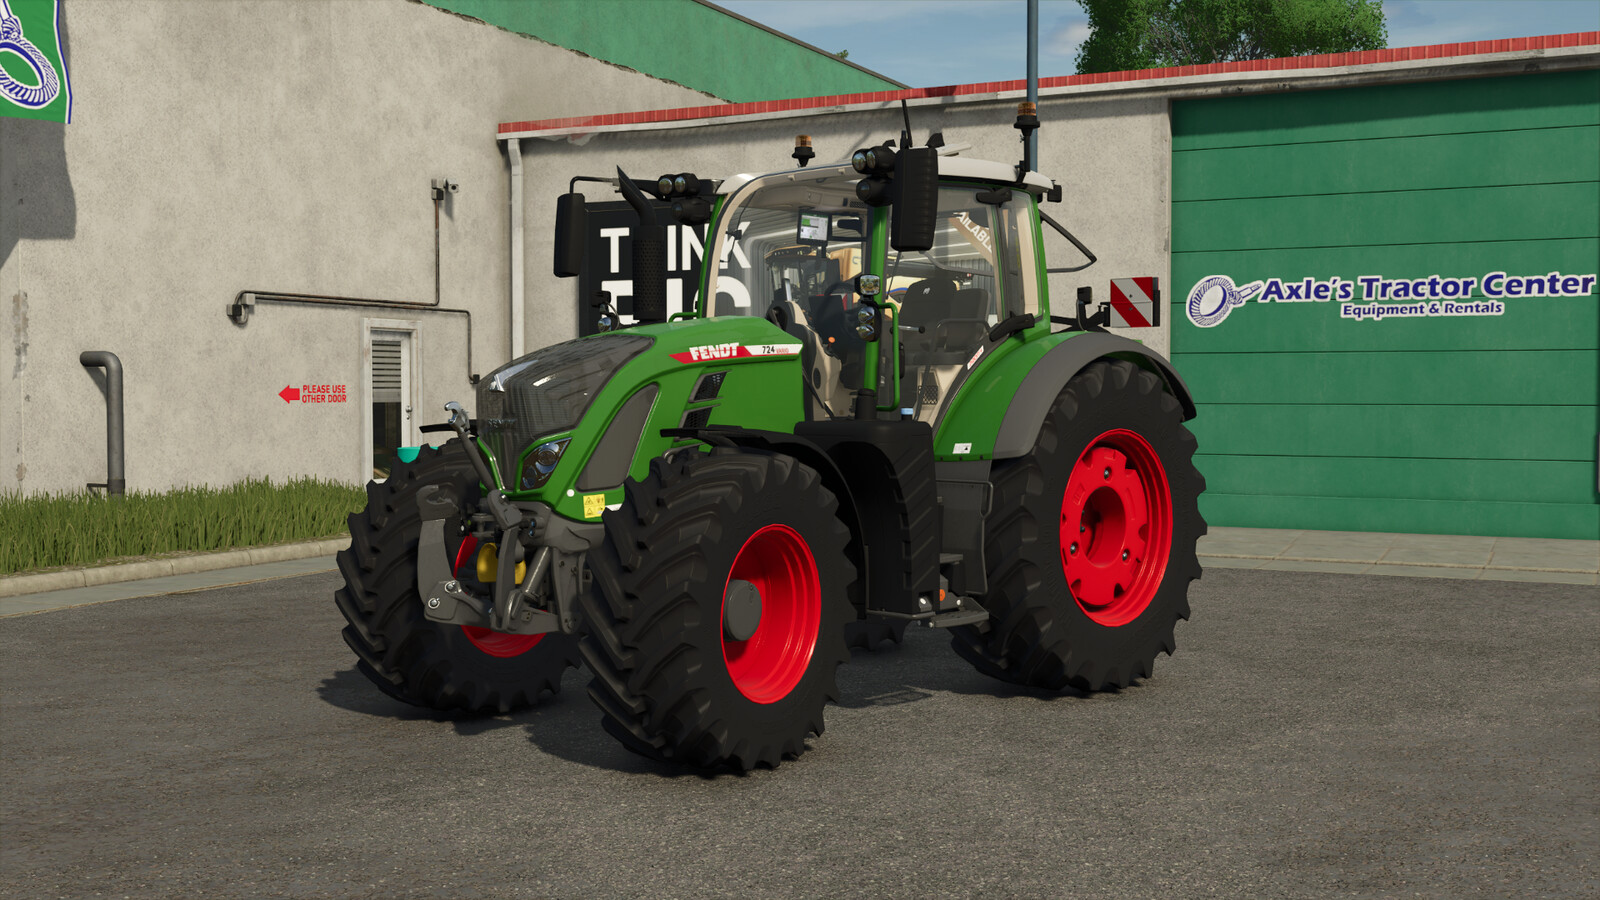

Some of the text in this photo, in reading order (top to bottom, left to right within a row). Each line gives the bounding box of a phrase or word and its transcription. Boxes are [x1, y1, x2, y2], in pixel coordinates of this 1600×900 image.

[600, 221, 751, 273] TINK
[1260, 273, 1595, 301] Axle's Tractor Center
[1343, 302, 1503, 318] Equipment & Rentals
[689, 342, 740, 361] FENDT
[762, 345, 775, 354] 724
[302, 384, 347, 394] PLEASE USE
[301, 394, 347, 404] OTHER DOOR
